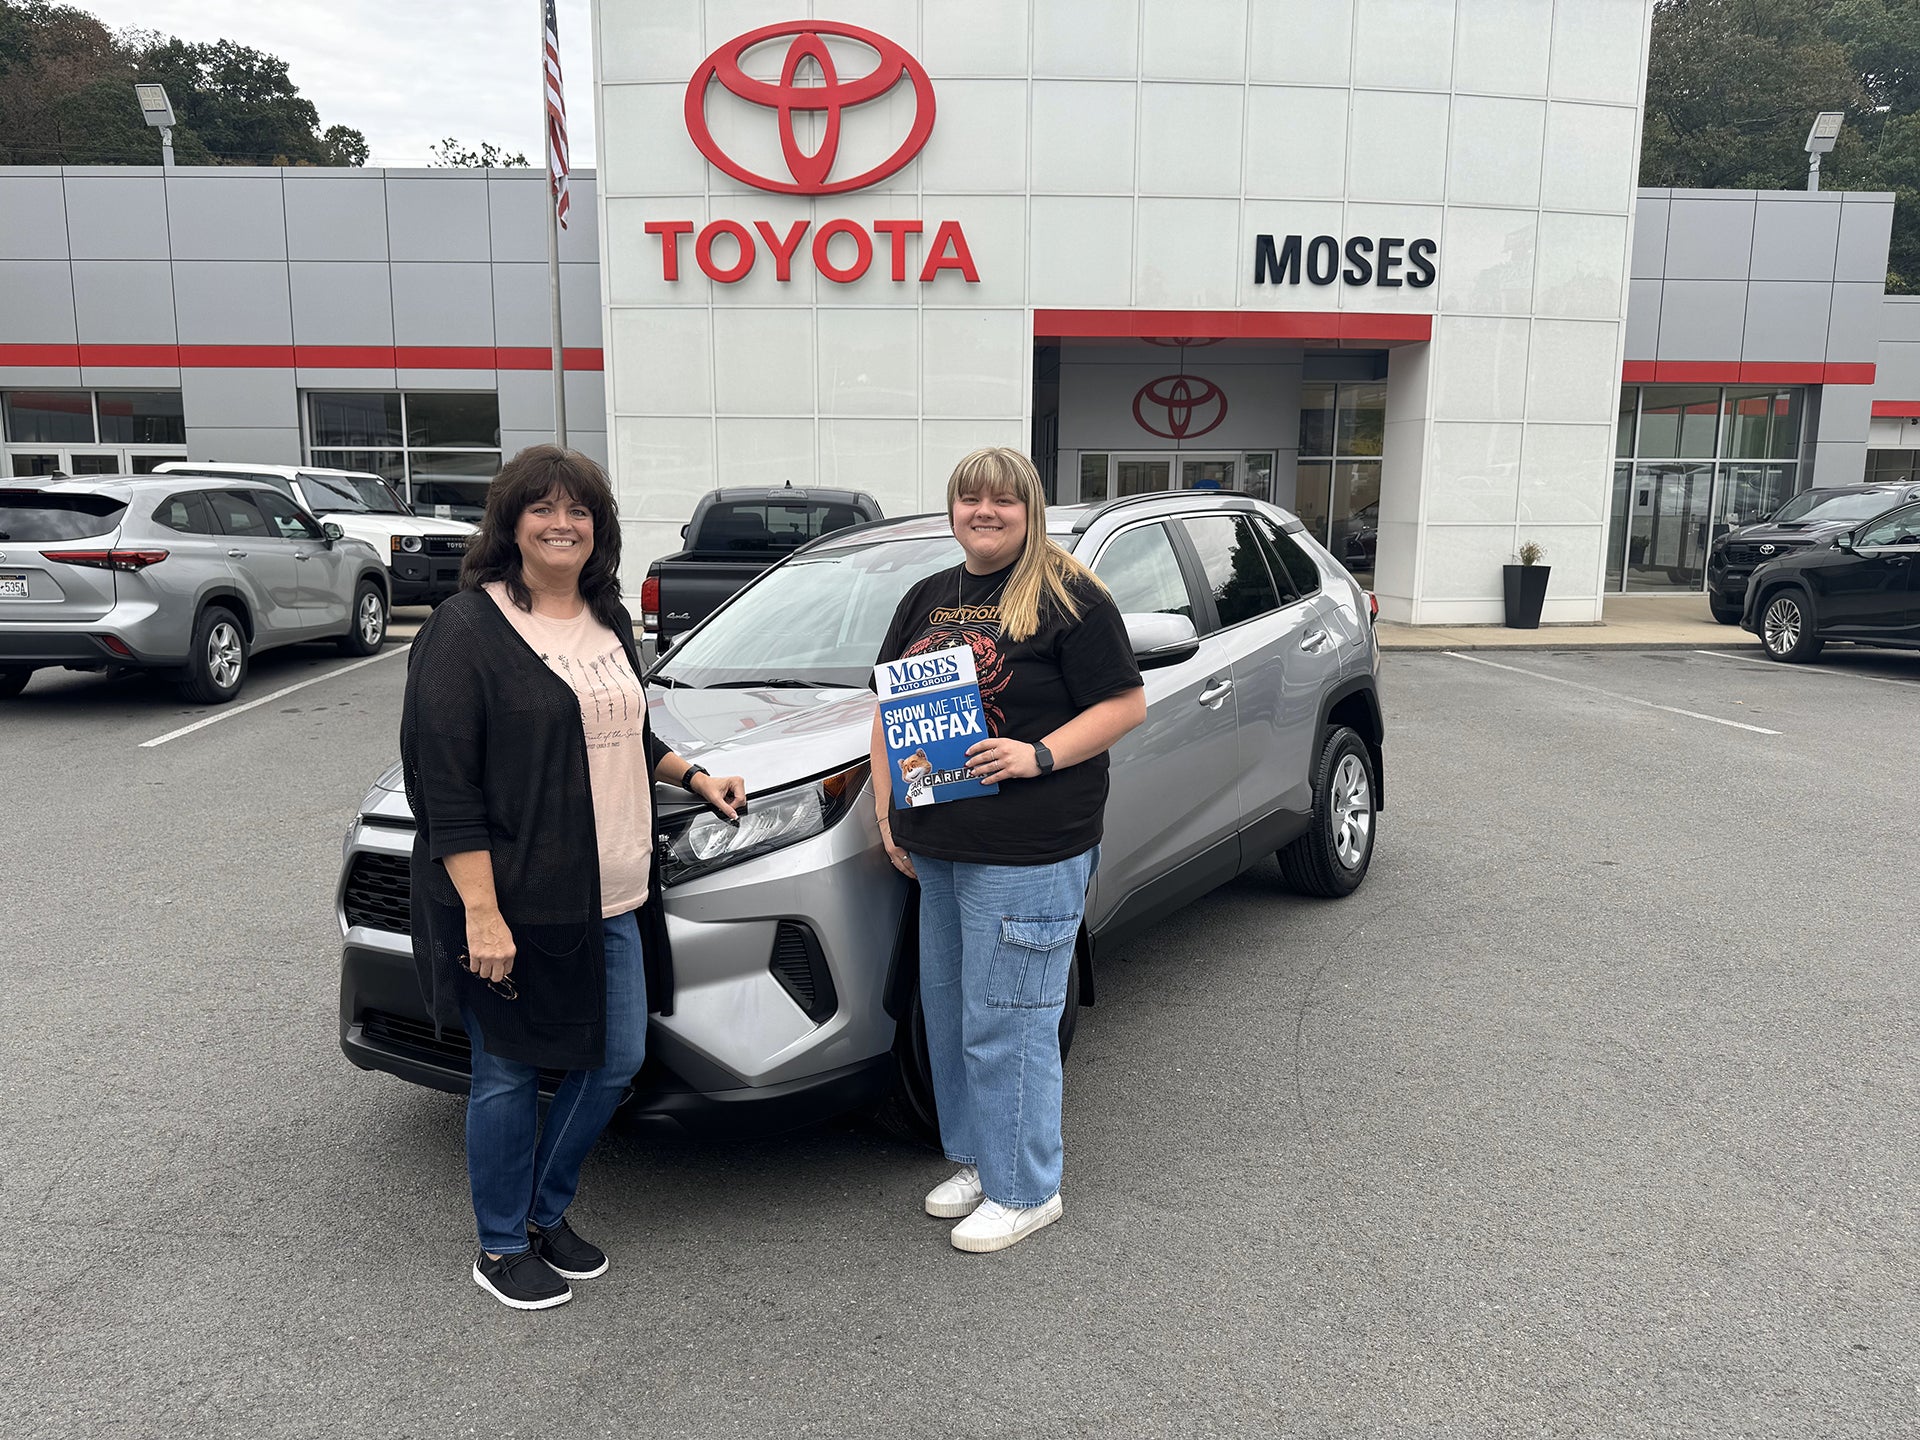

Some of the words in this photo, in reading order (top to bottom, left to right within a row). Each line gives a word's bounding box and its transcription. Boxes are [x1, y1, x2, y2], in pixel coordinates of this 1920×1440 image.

[644, 219, 981, 284] TOYOTA
[1254, 234, 1437, 288] MOSES
[887, 655, 957, 686] MOSES
[897, 681, 920, 692] AUTO
[922, 675, 952, 687] GROUP
[884, 703, 925, 726] SHOW
[929, 698, 950, 717] ME
[951, 693, 977, 711] THE
[887, 708, 982, 750] CARFAX
[924, 767, 988, 786] CARFA
